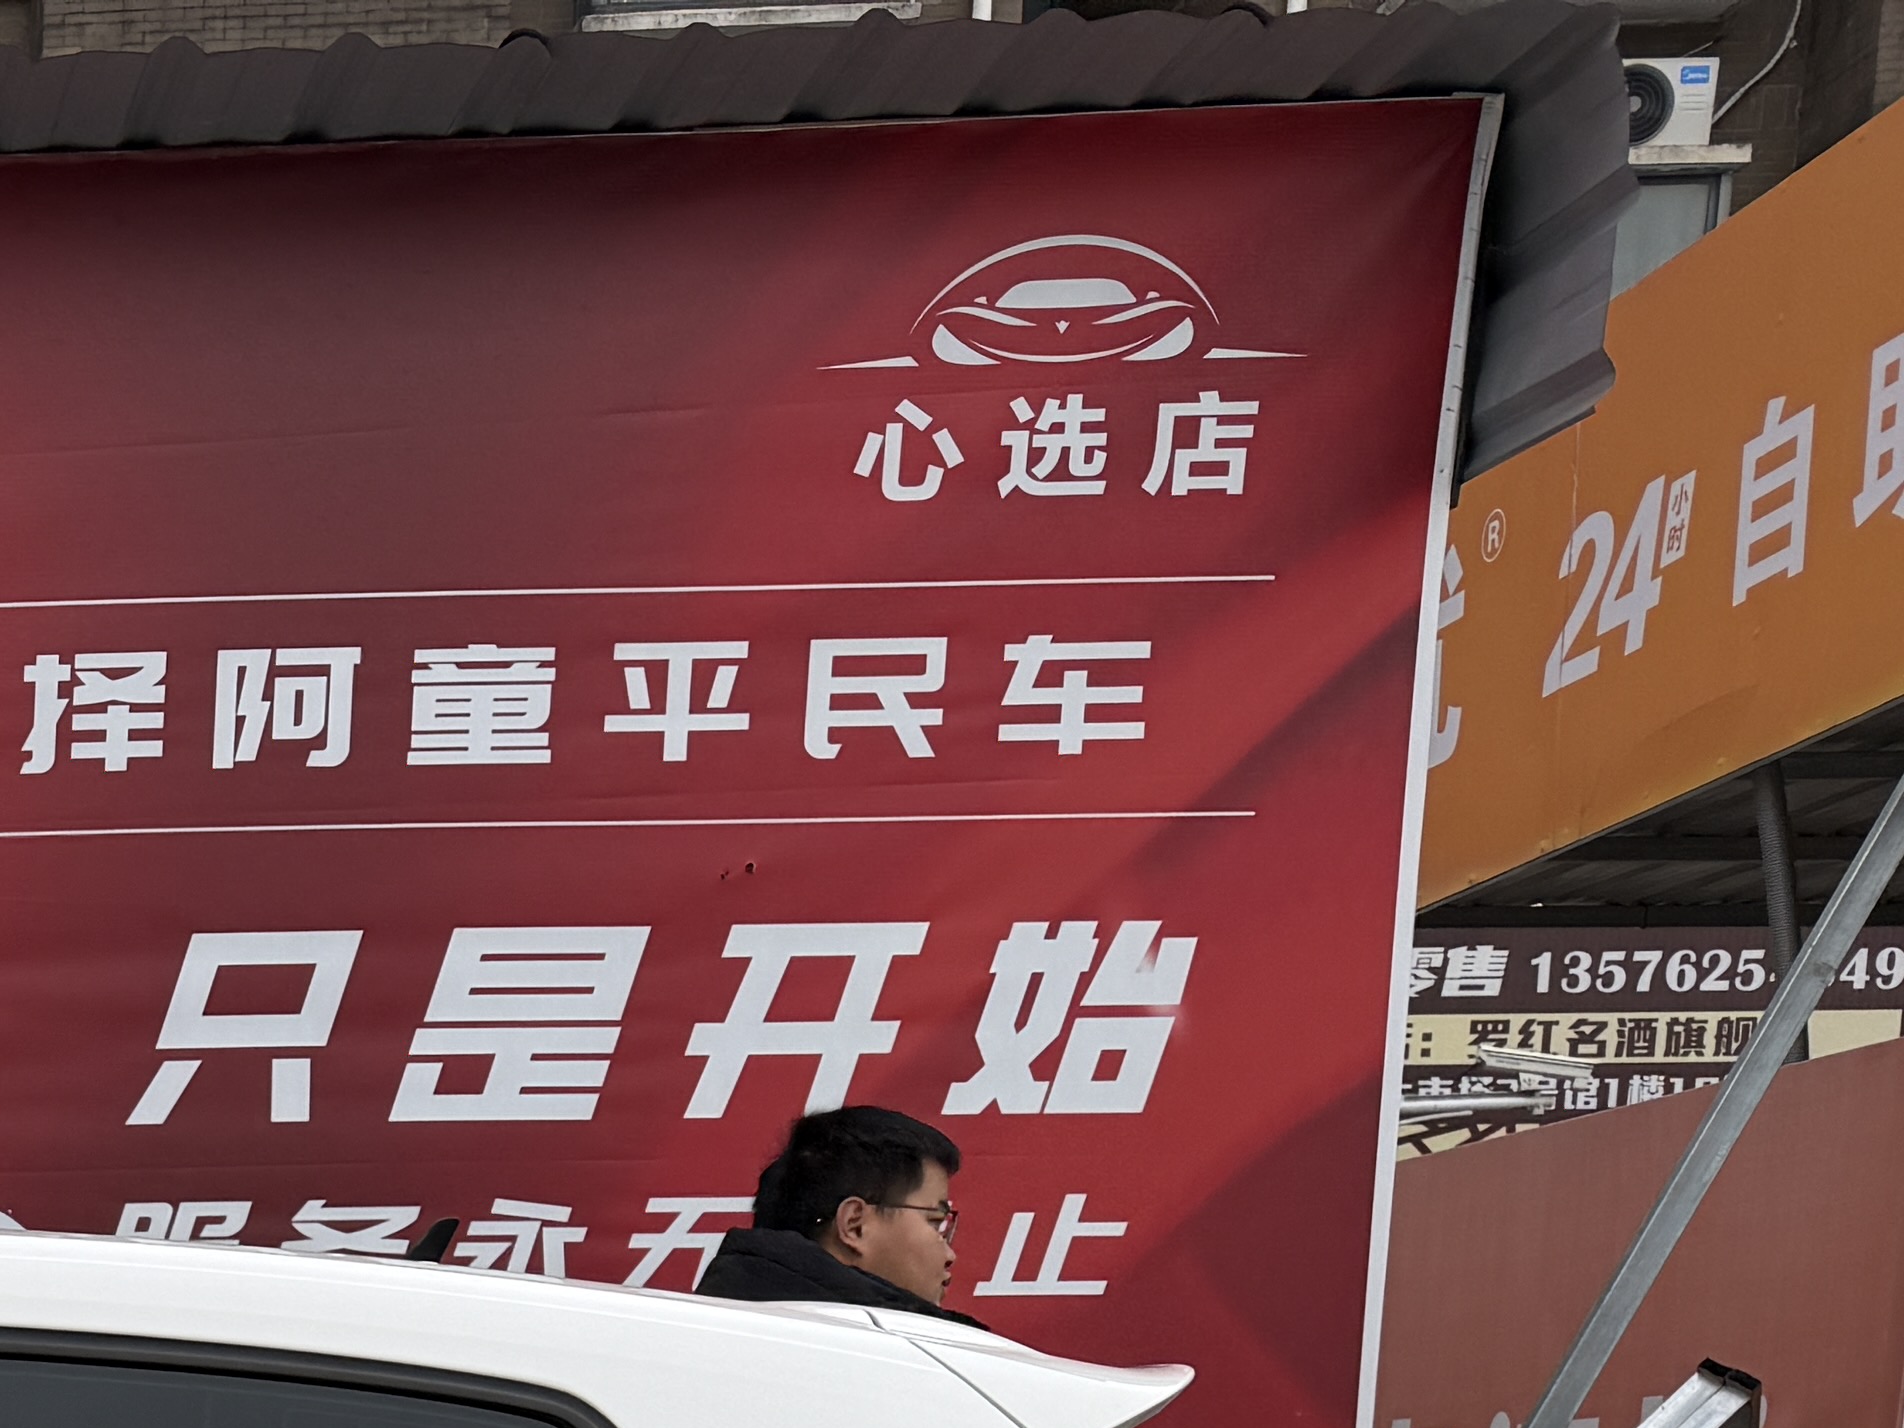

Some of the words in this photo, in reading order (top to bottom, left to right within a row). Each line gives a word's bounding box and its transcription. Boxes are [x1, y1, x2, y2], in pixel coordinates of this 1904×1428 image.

[853, 390, 1260, 502] 心选店
[1542, 475, 1666, 698] 24
